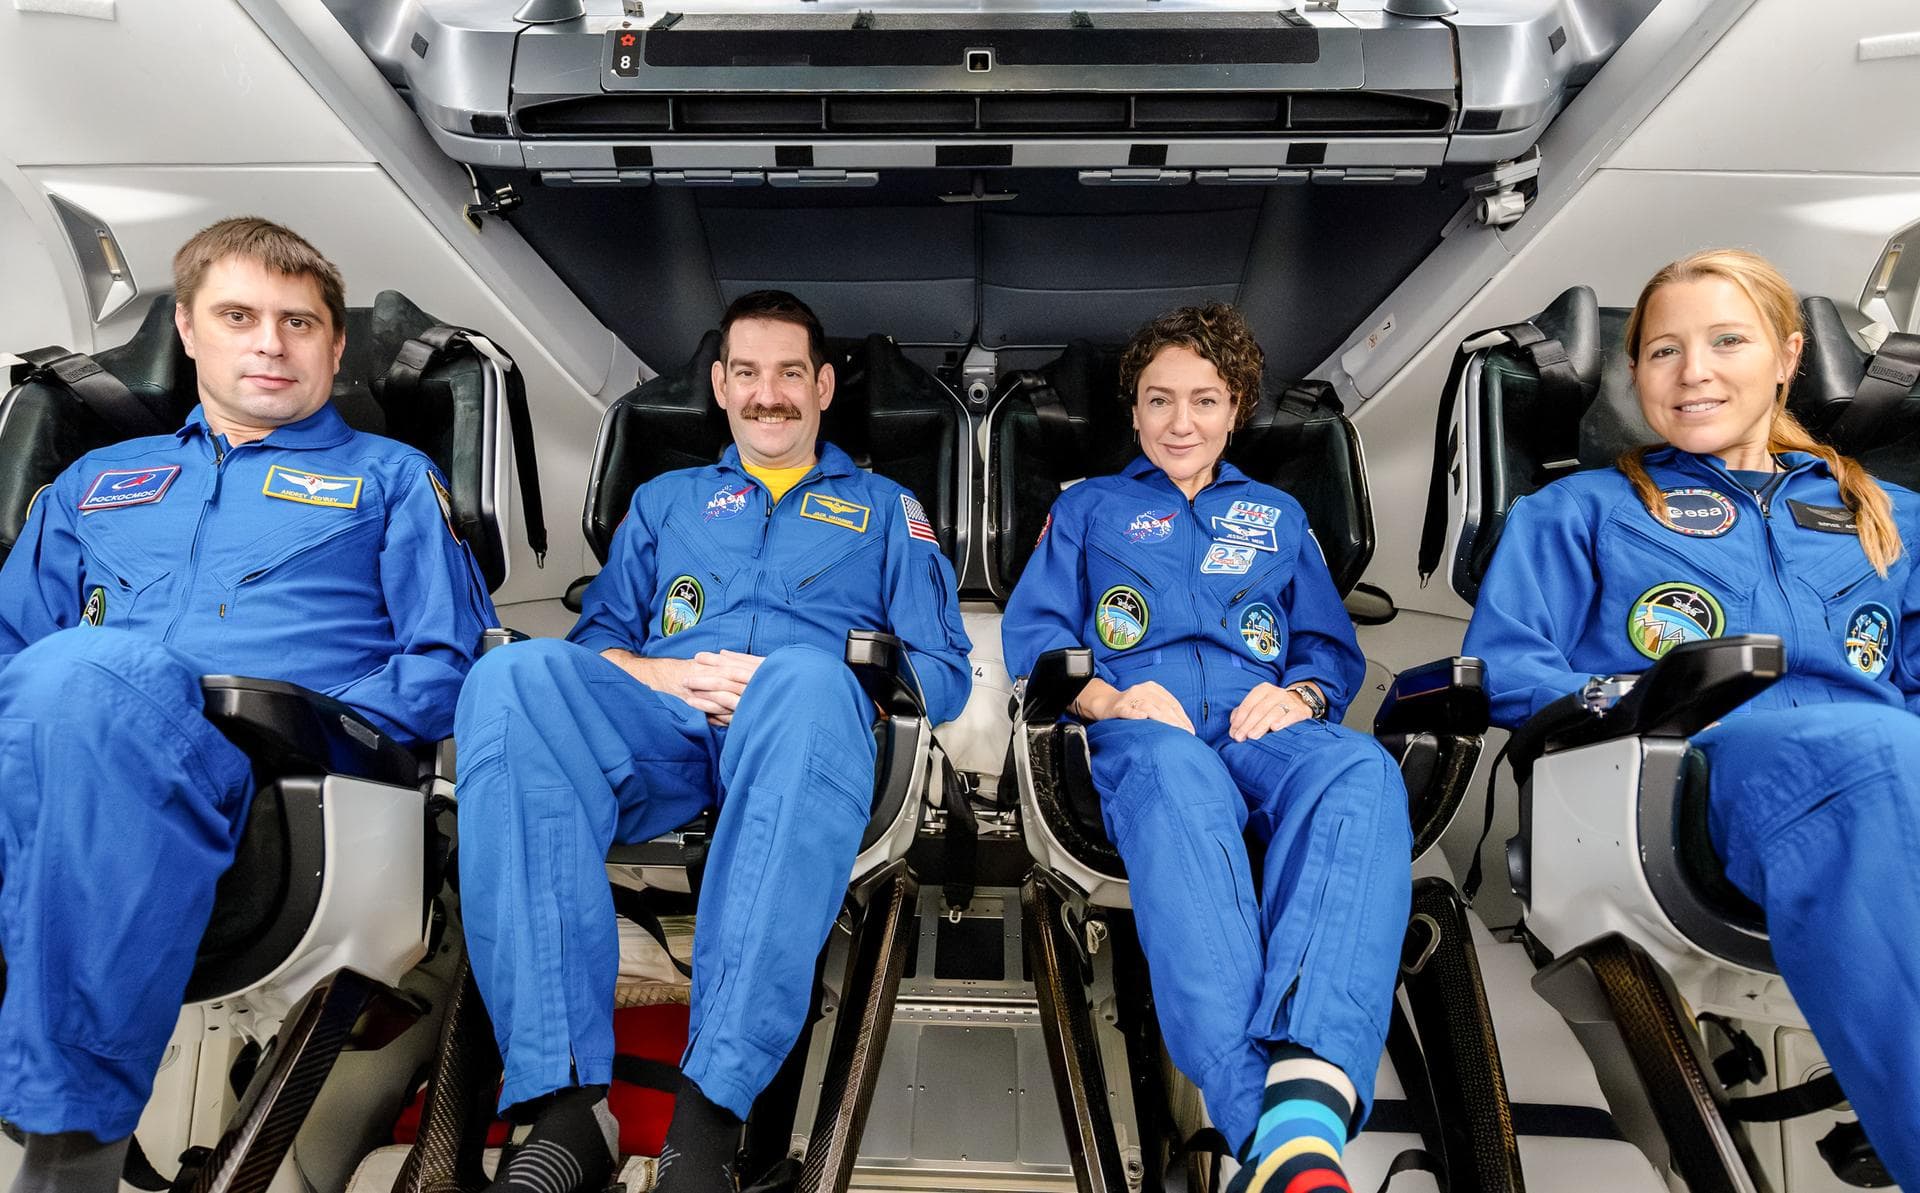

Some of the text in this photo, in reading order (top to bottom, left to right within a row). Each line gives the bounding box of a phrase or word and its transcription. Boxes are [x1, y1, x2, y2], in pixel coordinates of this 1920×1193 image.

[620, 55, 630, 69] 8
[89, 489, 156, 503] РОСКОСМОС
[706, 494, 746, 510] NASA
[1130, 519, 1173, 532] NASA
